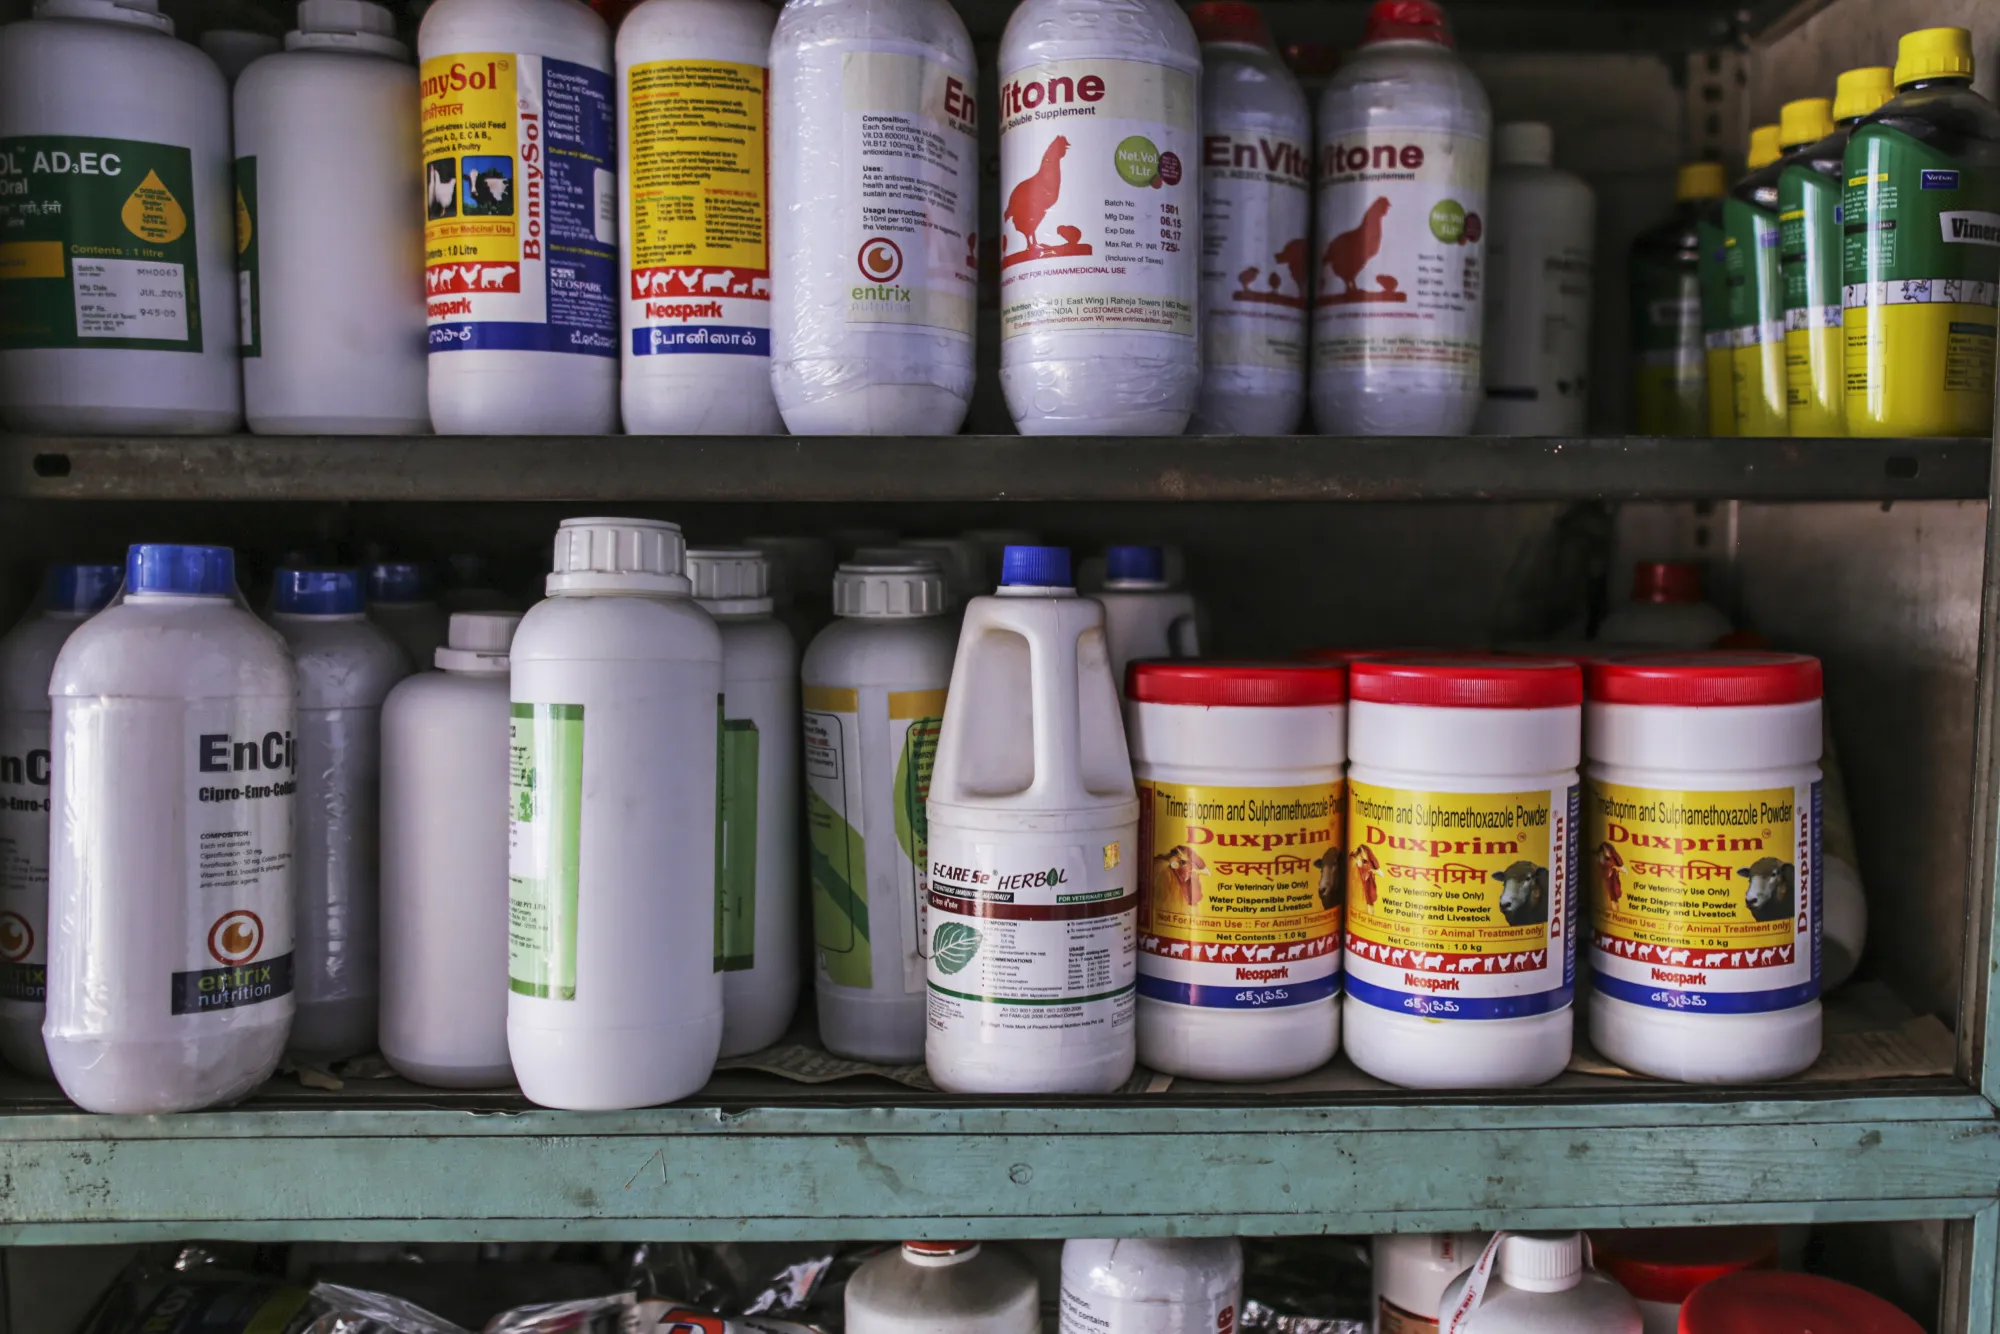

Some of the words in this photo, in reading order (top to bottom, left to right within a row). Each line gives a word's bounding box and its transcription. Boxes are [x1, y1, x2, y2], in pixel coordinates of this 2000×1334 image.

[465, 122, 486, 130] Liquid
[488, 121, 506, 129] Feed
[1008, 114, 1032, 130] Soluble
[1034, 106, 1096, 120] Supplement
[518, 112, 543, 262] BonnySol
[496, 225, 510, 233] Use
[1105, 213, 1118, 222] Mfg
[1160, 216, 1182, 228] 06.15
[1105, 227, 1118, 235] Exp
[1160, 230, 1182, 241] 06.17
[71, 244, 123, 255] Contents
[460, 246, 477, 255] Litre
[1029, 271, 1042, 279] FOR
[1043, 266, 1109, 277] HUMAN/MEDICINAL
[1111, 267, 1127, 275] USE
[852, 284, 910, 302] entrix
[1085, 297, 1104, 305] Wing
[1110, 297, 1136, 306] Raheja
[646, 301, 723, 322] Neospark
[852, 302, 910, 313] nutrition
[1165, 795, 1224, 824] Trimethoprim
[1226, 801, 1245, 821] and
[1248, 797, 1328, 827] Sulphamethoxazole
[1396, 804, 1413, 825] and
[1416, 803, 1513, 832] Sulphamethoxazole
[1516, 805, 1548, 827] Powder
[1639, 802, 1656, 823] and
[1659, 801, 1757, 830] Sulphamethoxazole
[1760, 802, 1792, 824] Powder
[200, 831, 248, 840] COMPOSITION
[1186, 826, 1330, 851] Duxprim
[1366, 825, 1518, 857] Duxprim
[1608, 823, 1763, 855] Duxprim
[933, 861, 970, 882] E-CARE
[1551, 816, 1565, 940] Duxprim
[1798, 813, 1810, 935] Duxprim
[1235, 884, 1275, 892] Veterinary
[1291, 881, 1309, 889] Only)
[1404, 886, 1443, 900] Veterinary
[1445, 891, 1460, 899] Use
[1462, 891, 1485, 901] Only)
[1649, 884, 1688, 896] Veterinary
[1691, 888, 1705, 896] Use
[1708, 888, 1730, 897] Only)
[1226, 905, 1258, 914] Poultry
[1278, 902, 1313, 912] Livestock
[1236, 896, 1284, 905] Dispersible
[1286, 894, 1313, 902] Powder
[1382, 897, 1402, 908] Water
[1405, 900, 1454, 913] Dispersible
[1457, 905, 1491, 914] Powder
[1627, 894, 1648, 904] Water
[1650, 897, 1700, 909] Dispersible
[1702, 901, 1737, 910] Powder
[1383, 906, 1394, 914] for
[1396, 908, 1425, 920] Poultry
[1428, 913, 1444, 921] and
[1447, 913, 1491, 922] Livestock
[1628, 902, 1639, 911] for
[1641, 905, 1671, 916] Poultry
[1673, 908, 1690, 917] and
[1693, 910, 1737, 919] Livestock
[1173, 915, 1187, 924] For
[1190, 918, 1221, 928] Human
[1224, 920, 1242, 928] Use
[1254, 920, 1270, 928] For
[1272, 918, 1301, 928] Animal
[1368, 914, 1392, 930] Human
[1394, 922, 1411, 933] Use
[1422, 926, 1439, 936] For
[1440, 928, 1475, 938] Animal
[1477, 927, 1524, 938] Treatment
[1612, 911, 1638, 926] Human
[1640, 917, 1656, 929] Use
[1668, 922, 1684, 932] For
[1686, 923, 1721, 933] Animal
[1725, 923, 1771, 933] Treatment
[1216, 933, 1232, 941] Net
[1234, 933, 1276, 941] Contents
[1297, 931, 1307, 939] kg
[1387, 936, 1402, 945] Net
[1405, 939, 1444, 950] Contents
[1454, 943, 1468, 951] 1.0
[1470, 943, 1482, 952] kg
[1633, 931, 1647, 940] Net
[1650, 934, 1691, 945] Contents
[1717, 939, 1729, 948] kg
[199, 966, 272, 993] entrix
[1236, 966, 1289, 983] Neospark
[1404, 973, 1460, 992] Neospark
[1652, 967, 1707, 986] Neospark
[199, 982, 272, 1008] nutrition
